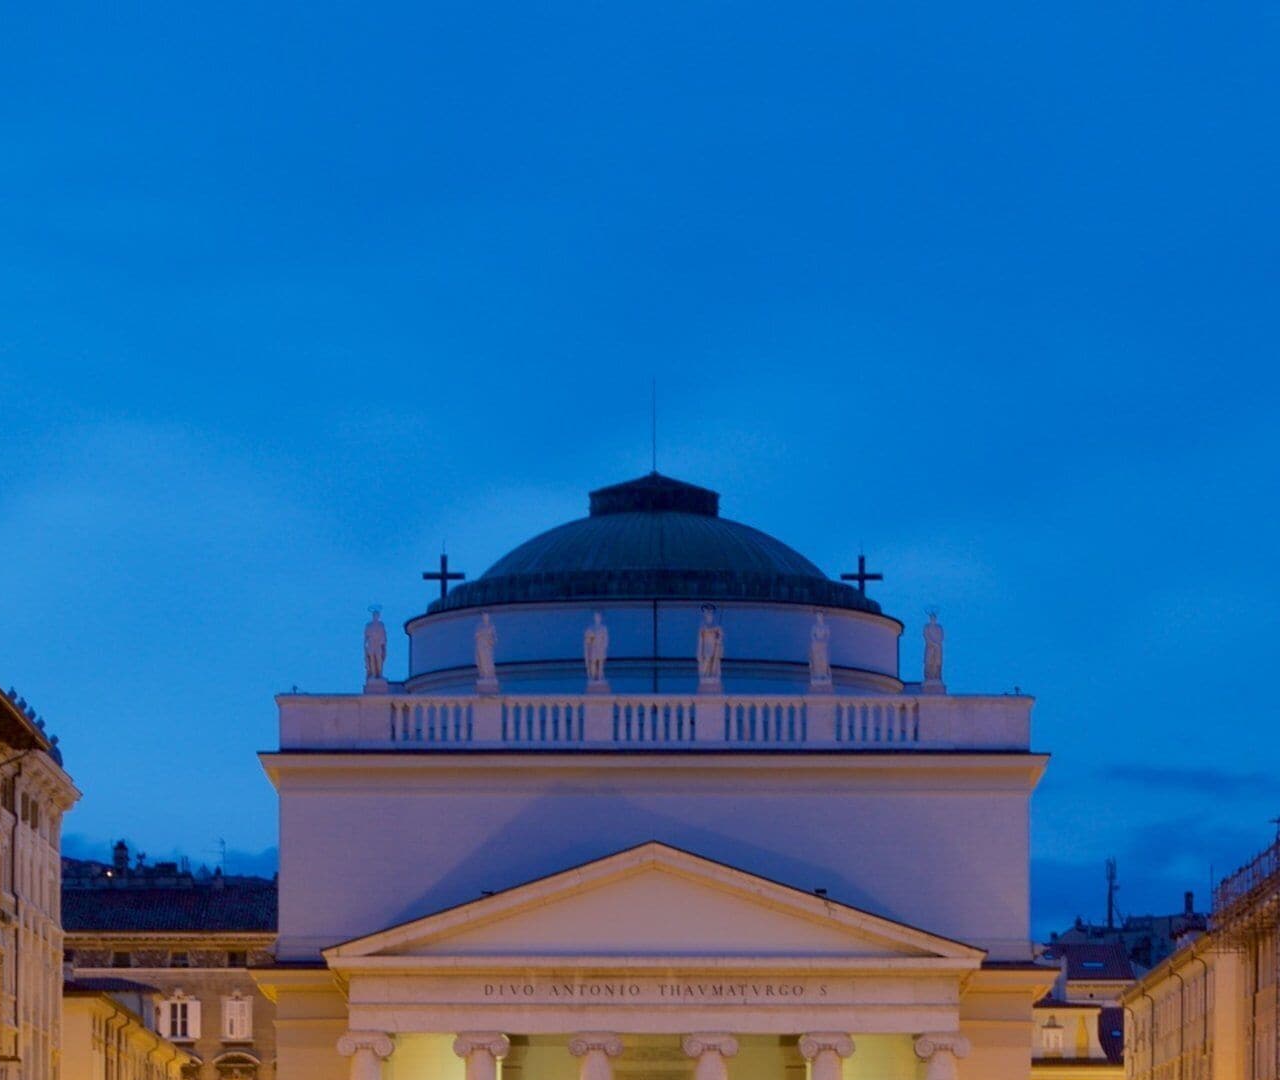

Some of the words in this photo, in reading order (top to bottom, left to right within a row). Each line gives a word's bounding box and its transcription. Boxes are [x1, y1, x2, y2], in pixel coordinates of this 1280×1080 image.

[483, 983, 534, 996] DIVO
[549, 983, 641, 996] ANTONIO
[657, 983, 804, 996] THAVMATVRGO
